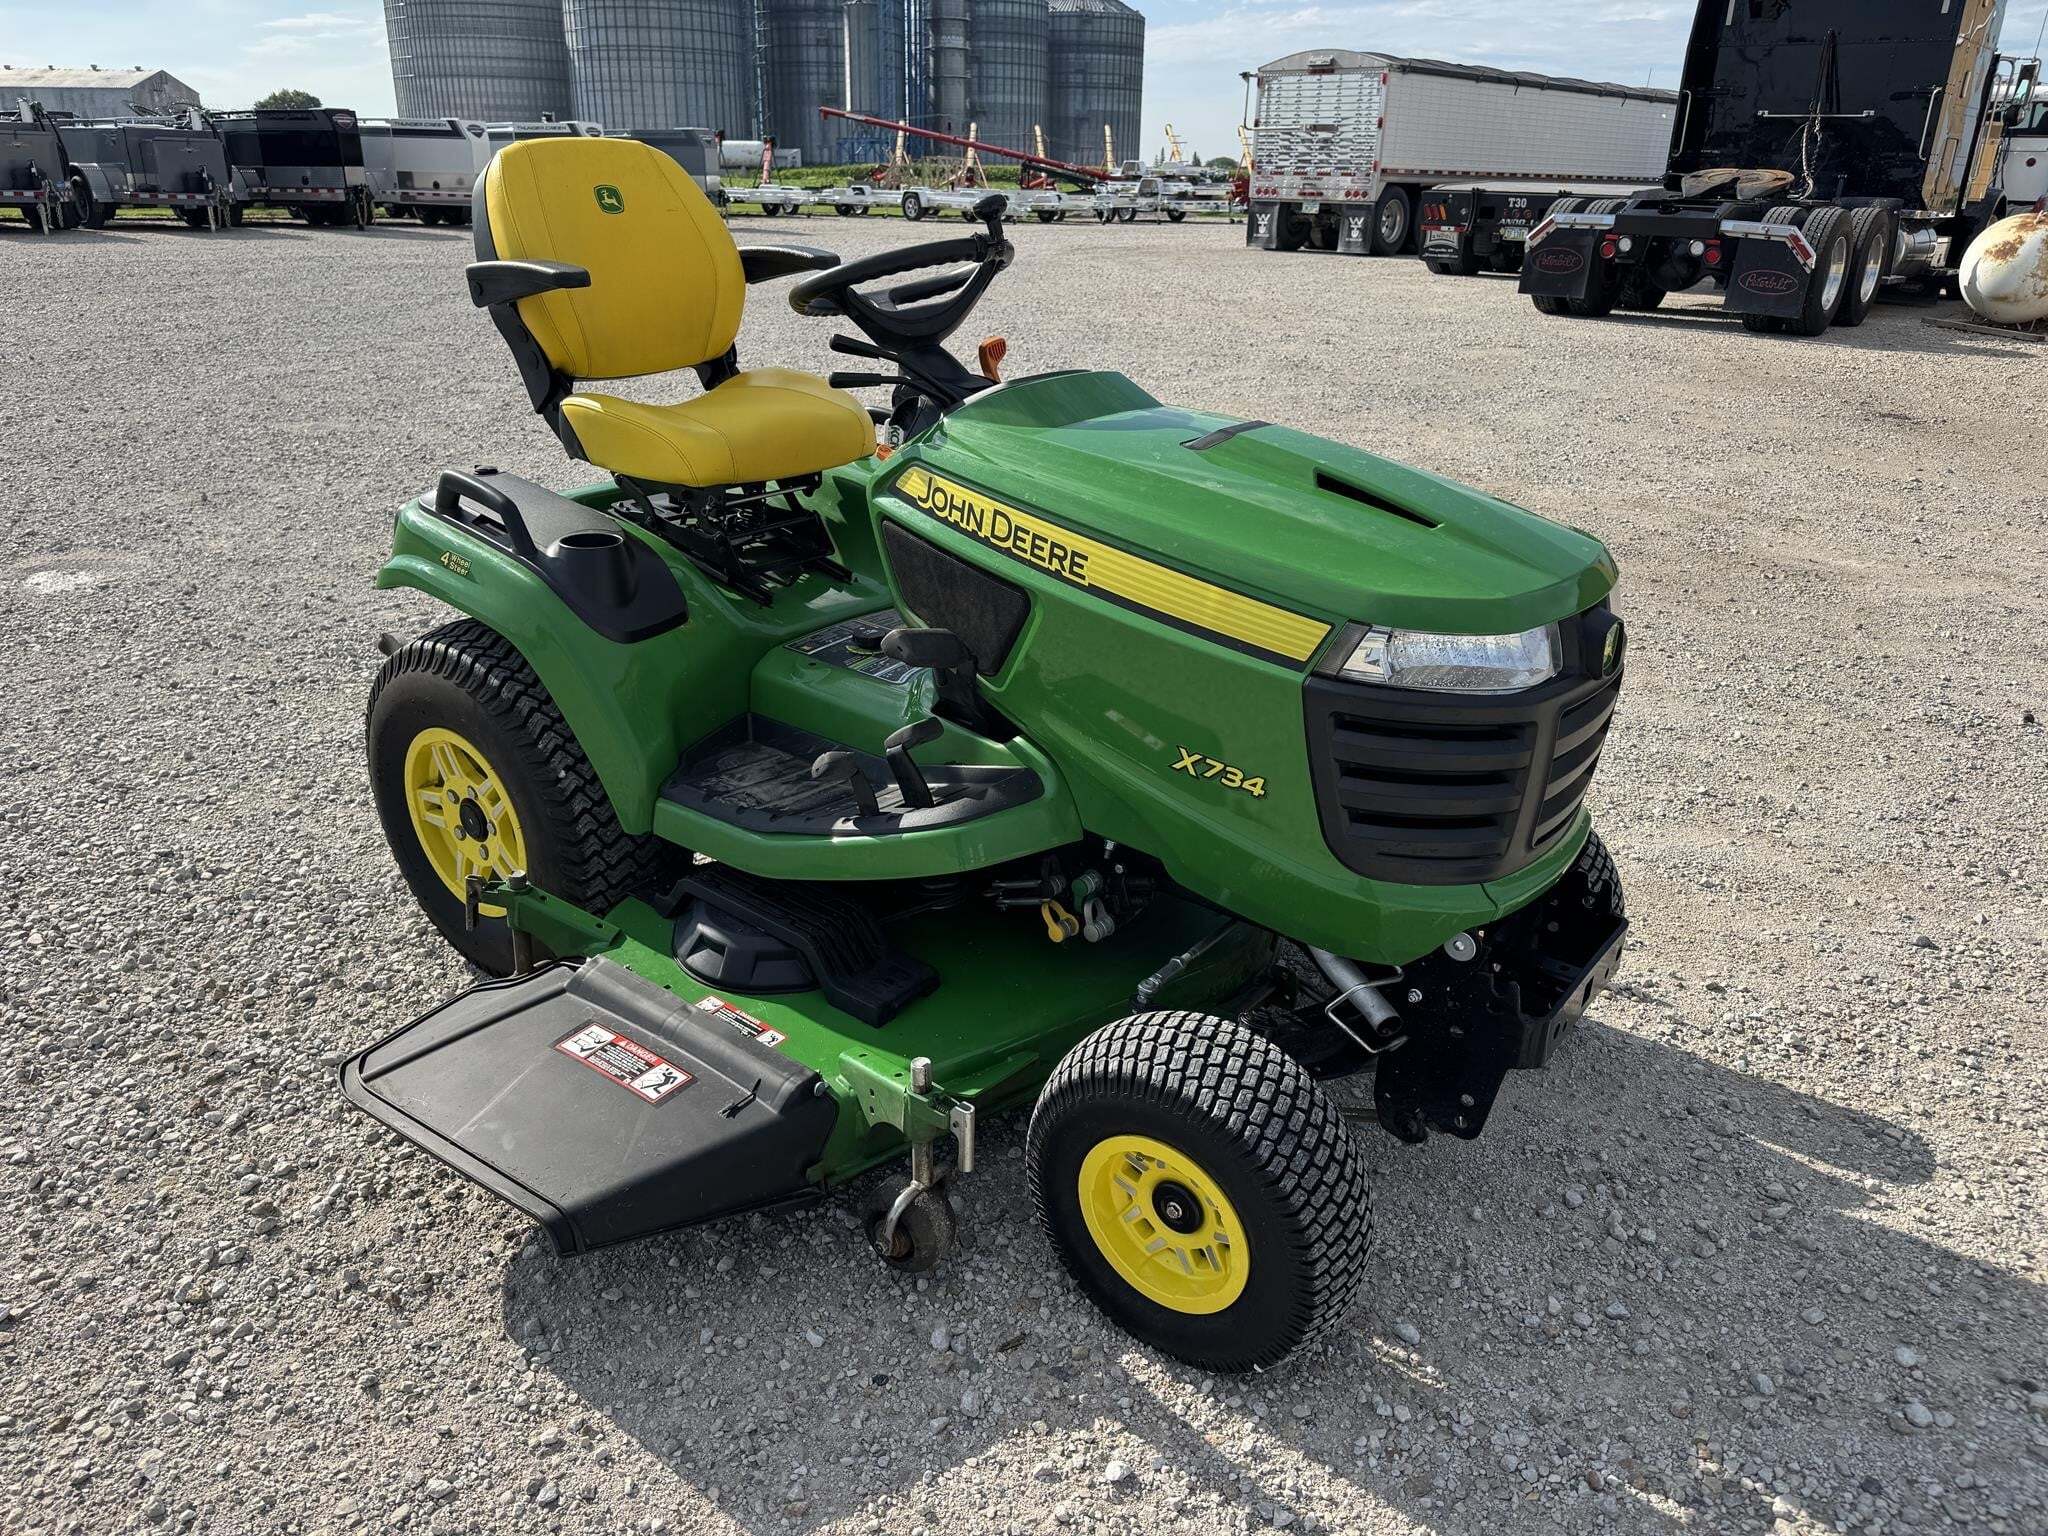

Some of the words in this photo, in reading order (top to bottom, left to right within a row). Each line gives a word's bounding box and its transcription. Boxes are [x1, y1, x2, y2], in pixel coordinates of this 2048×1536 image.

[1508, 197, 1527, 208] T30
[1745, 273, 1794, 290] Peterbilt
[916, 476, 985, 533] JOHN
[990, 508, 1089, 582] DEERE
[440, 551, 450, 566] 4
[451, 553, 471, 569] Wheel
[449, 561, 469, 576] Steer
[1168, 744, 1267, 798] X734
[626, 1042, 657, 1063] DANGER
